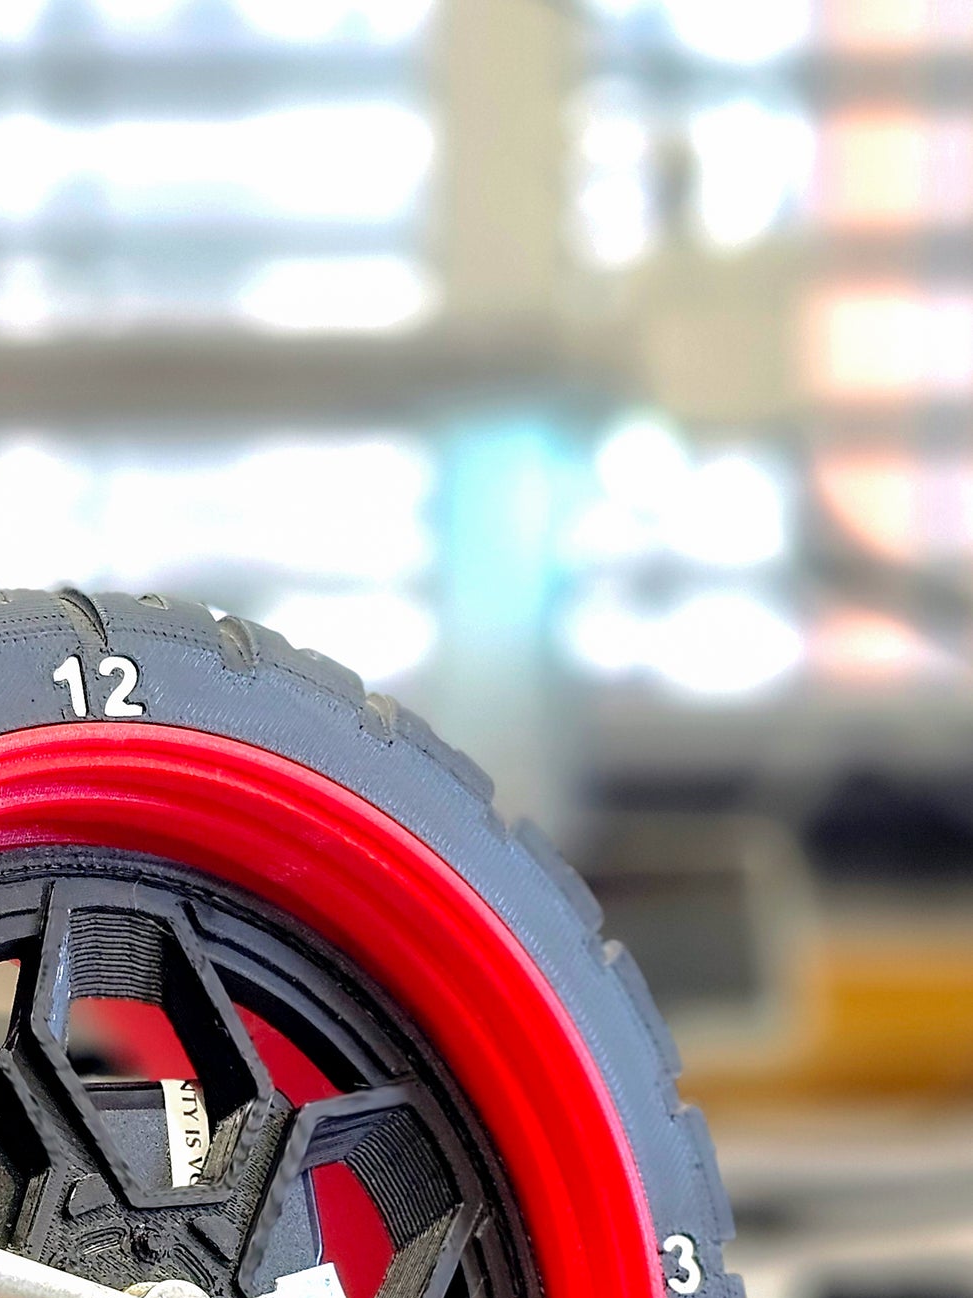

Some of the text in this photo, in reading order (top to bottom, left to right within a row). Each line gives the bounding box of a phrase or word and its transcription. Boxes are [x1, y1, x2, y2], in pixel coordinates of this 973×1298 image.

[53, 655, 143, 717] 12
[185, 1129, 202, 1148] IS
[663, 1234, 701, 1295] 3
